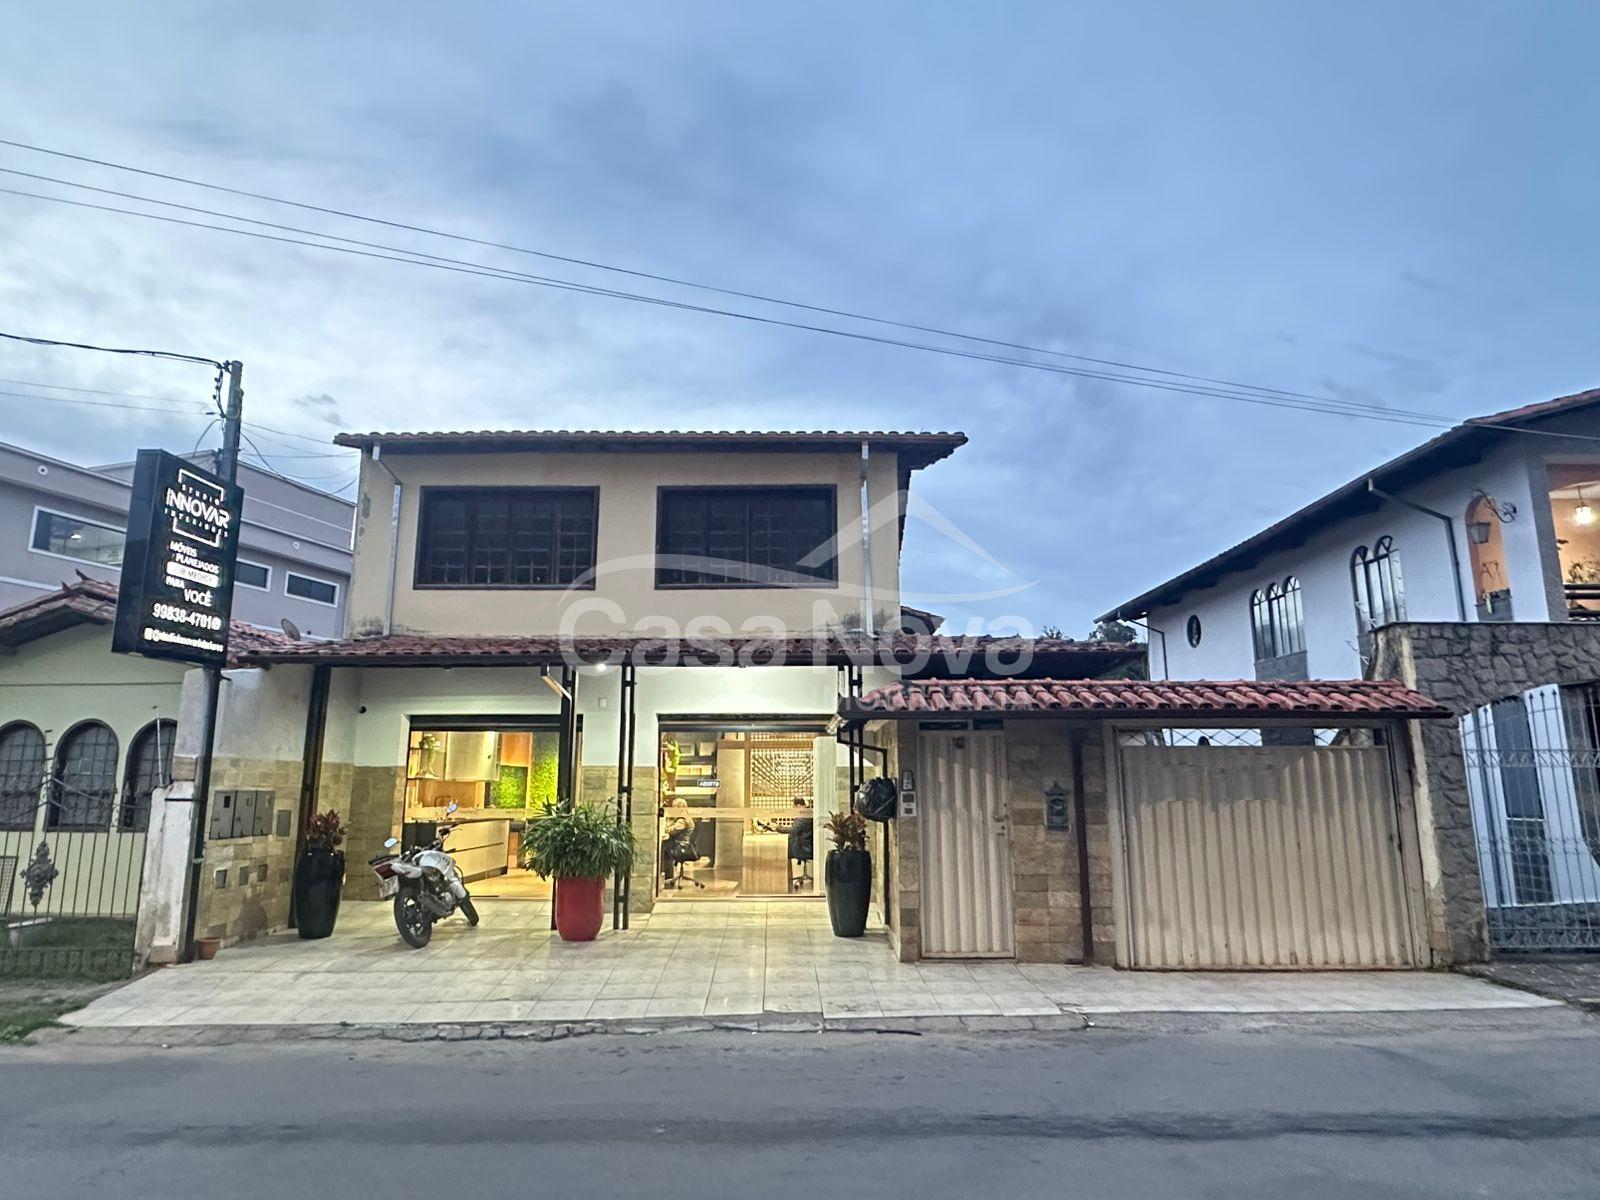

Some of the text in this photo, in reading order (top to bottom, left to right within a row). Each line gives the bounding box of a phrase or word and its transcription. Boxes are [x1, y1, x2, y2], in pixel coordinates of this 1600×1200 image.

[166, 488, 230, 529] INNOVAR
[170, 541, 198, 557] MÓVEIS
[176, 553, 220, 574] PLANEJADOS
[165, 576, 185, 589] PARA
[184, 588, 213, 607] VOCÊ
